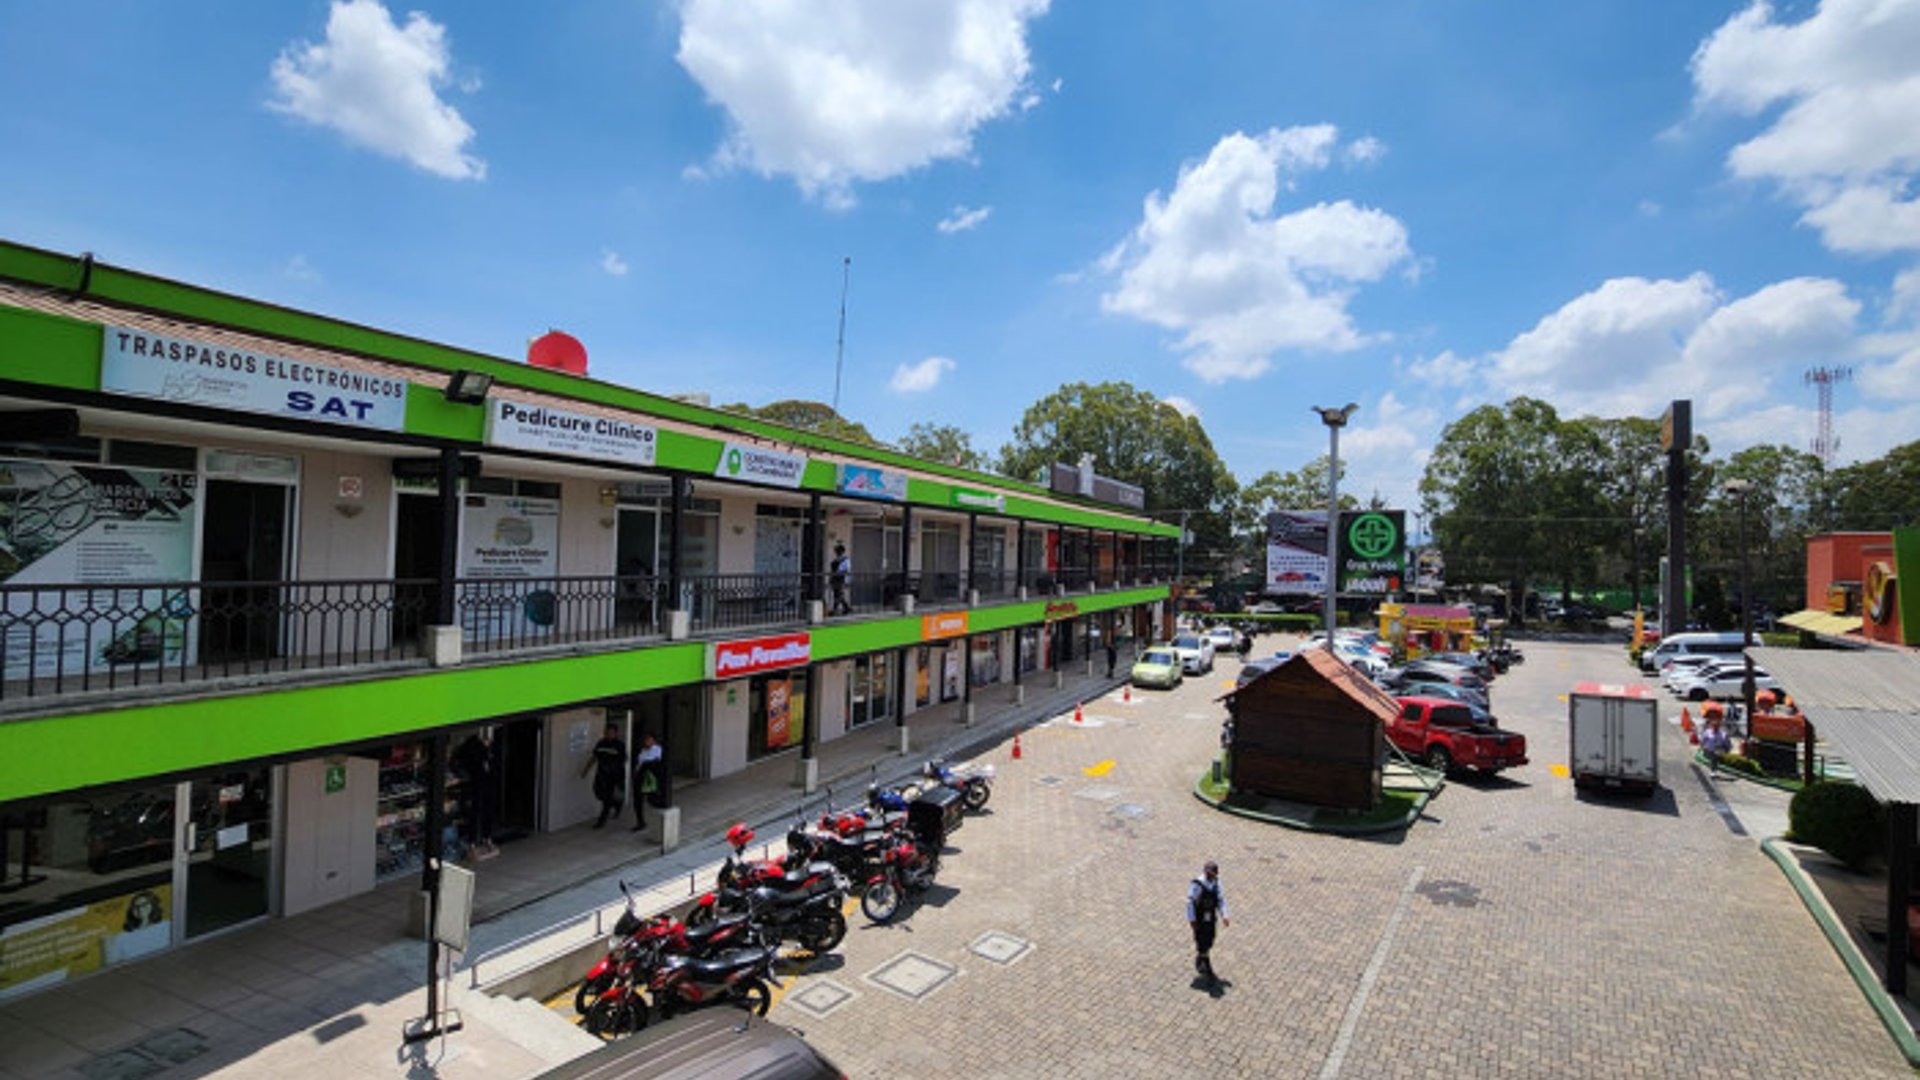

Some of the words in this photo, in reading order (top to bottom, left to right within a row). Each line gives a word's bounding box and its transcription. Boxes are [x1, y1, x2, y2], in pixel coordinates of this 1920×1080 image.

[117, 332, 257, 374] TRASPASOS
[265, 360, 404, 399] ELECTRÓNICOS
[286, 390, 374, 421] SAT
[501, 403, 591, 433] Pedicure
